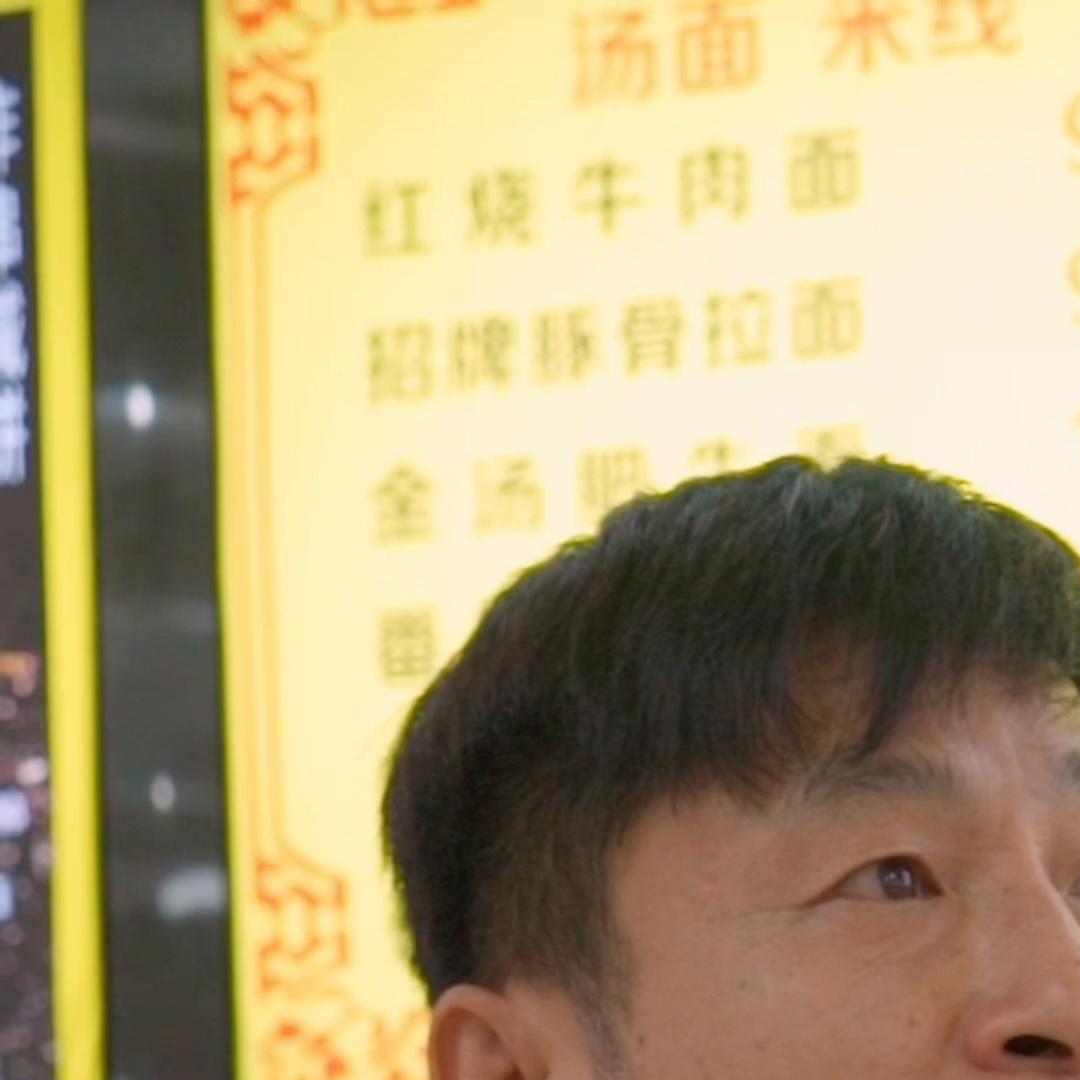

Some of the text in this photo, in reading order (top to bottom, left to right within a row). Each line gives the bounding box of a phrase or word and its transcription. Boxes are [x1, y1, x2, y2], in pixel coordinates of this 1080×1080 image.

[570, 0, 762, 110] 汤面
[362, 128, 863, 258] 红烧牛肉面
[366, 276, 864, 406] 招牌豚骨拉面
